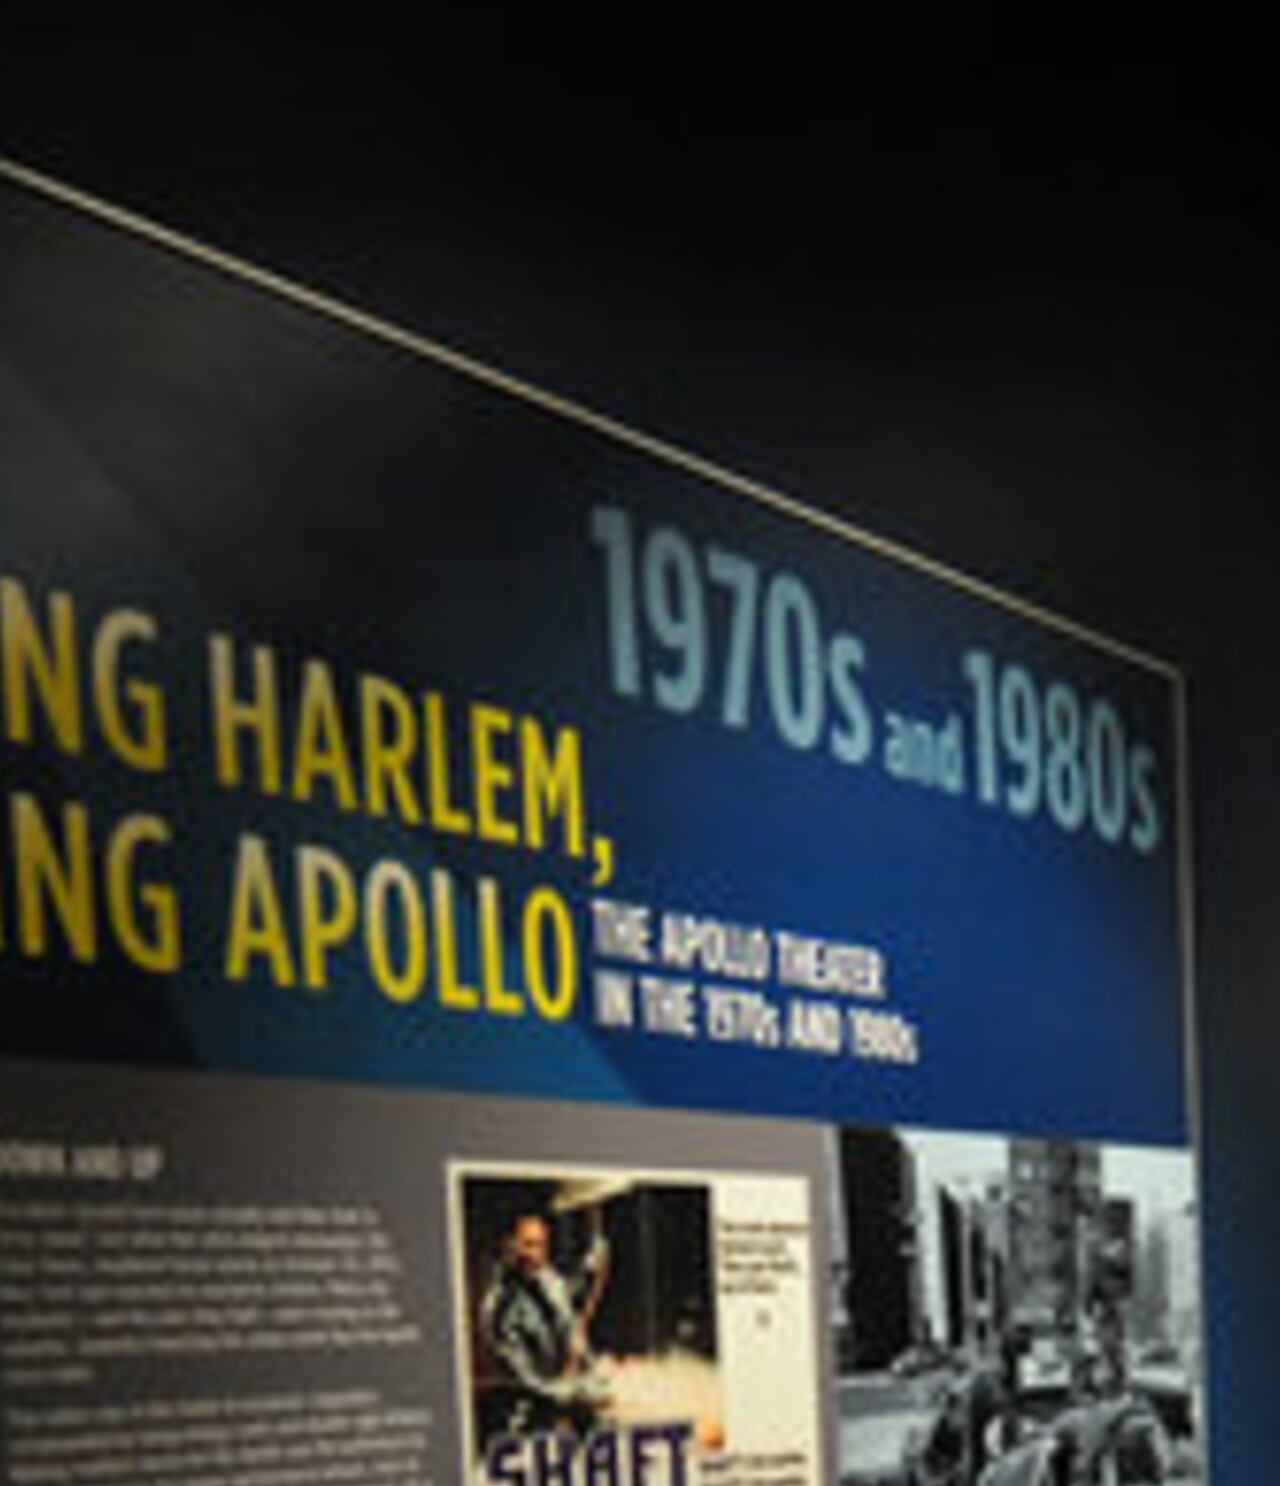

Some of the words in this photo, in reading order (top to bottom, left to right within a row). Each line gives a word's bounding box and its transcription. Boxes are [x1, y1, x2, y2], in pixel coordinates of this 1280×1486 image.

[210, 630, 614, 886] HARLEM,
[592, 506, 873, 767] 1970s
[885, 711, 961, 796] and
[963, 650, 1160, 855] 1980s
[225, 833, 575, 1019] APOLLO
[592, 898, 652, 963] THE
[660, 911, 771, 981] APOLLO
[776, 930, 888, 1000] THEATER
[593, 968, 633, 1028] IN
[640, 975, 696, 1038] THE
[704, 984, 781, 1049] 1970s
[787, 998, 842, 1056] AND
